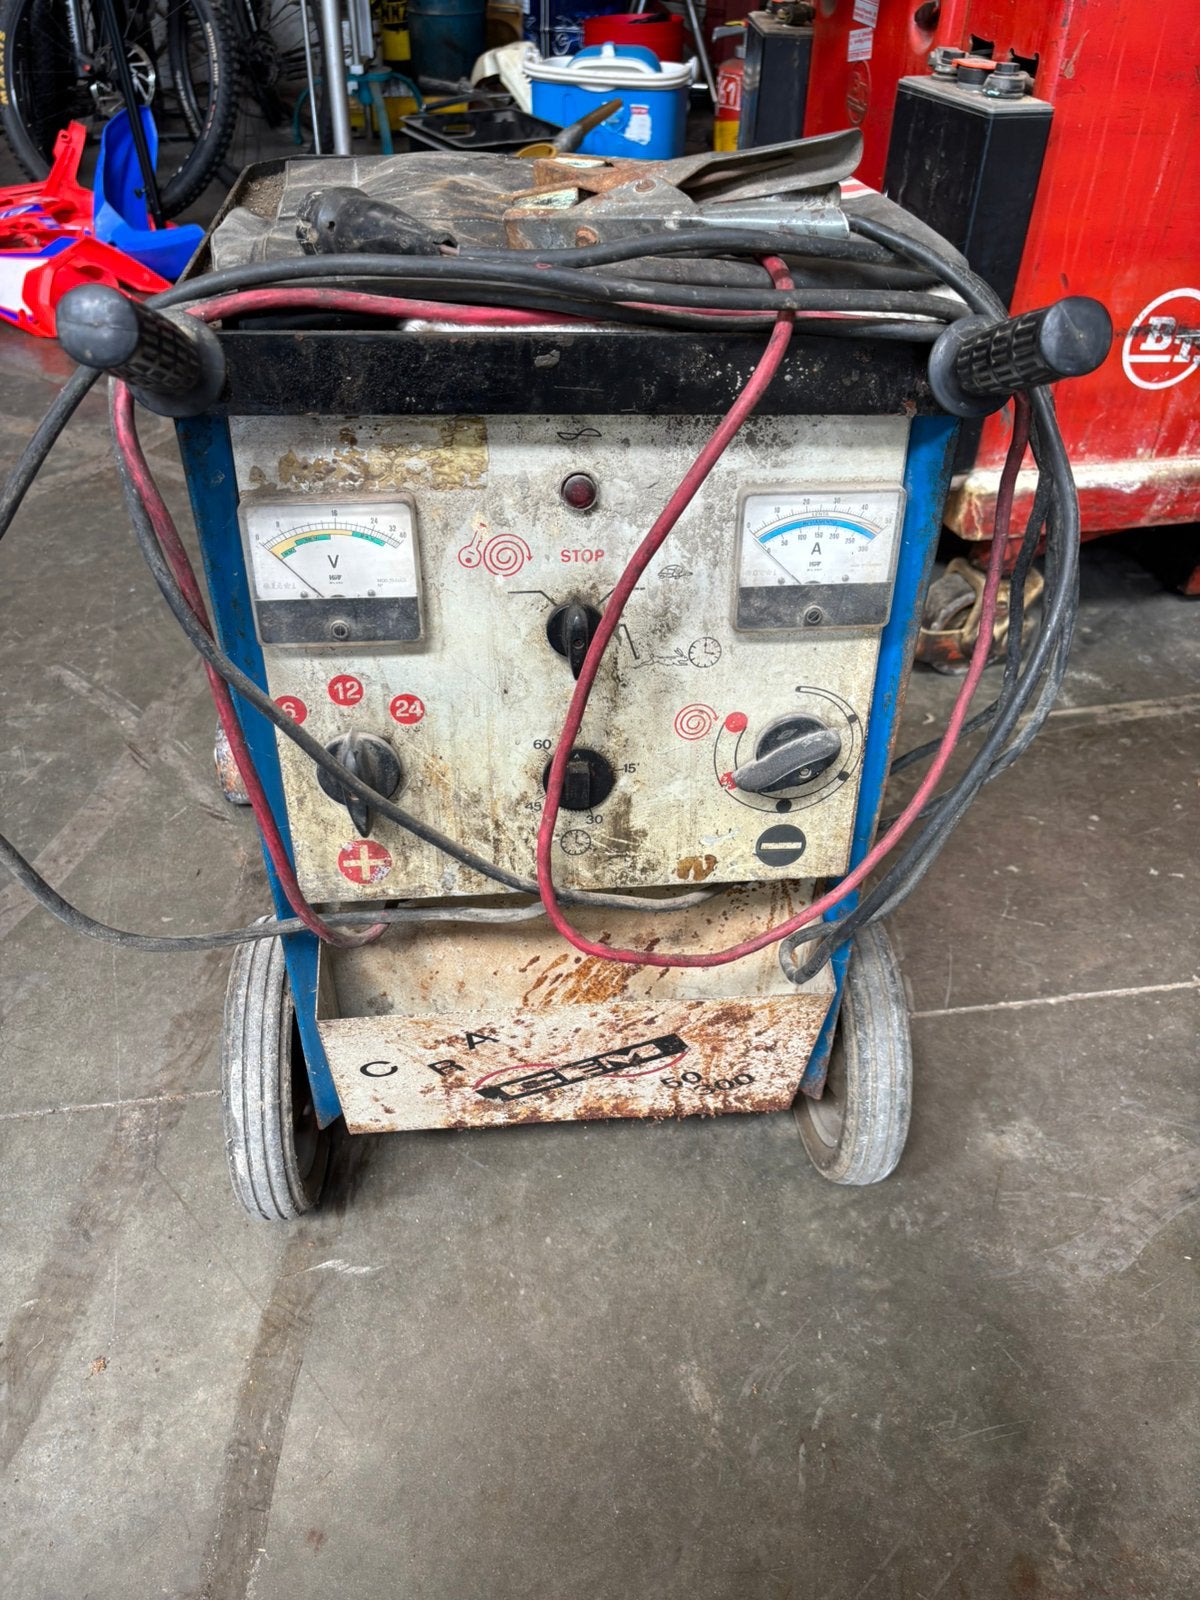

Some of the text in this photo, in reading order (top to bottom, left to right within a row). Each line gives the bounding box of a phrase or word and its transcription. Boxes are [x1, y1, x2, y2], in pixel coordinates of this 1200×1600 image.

[560, 549, 605, 564] STOP
[810, 542, 822, 555] A
[327, 554, 339, 569] V
[334, 681, 360, 700] 12
[281, 701, 296, 720] 6
[395, 699, 423, 718] 24
[524, 801, 542, 812] 45
[660, 1071, 755, 1096] 50 300
